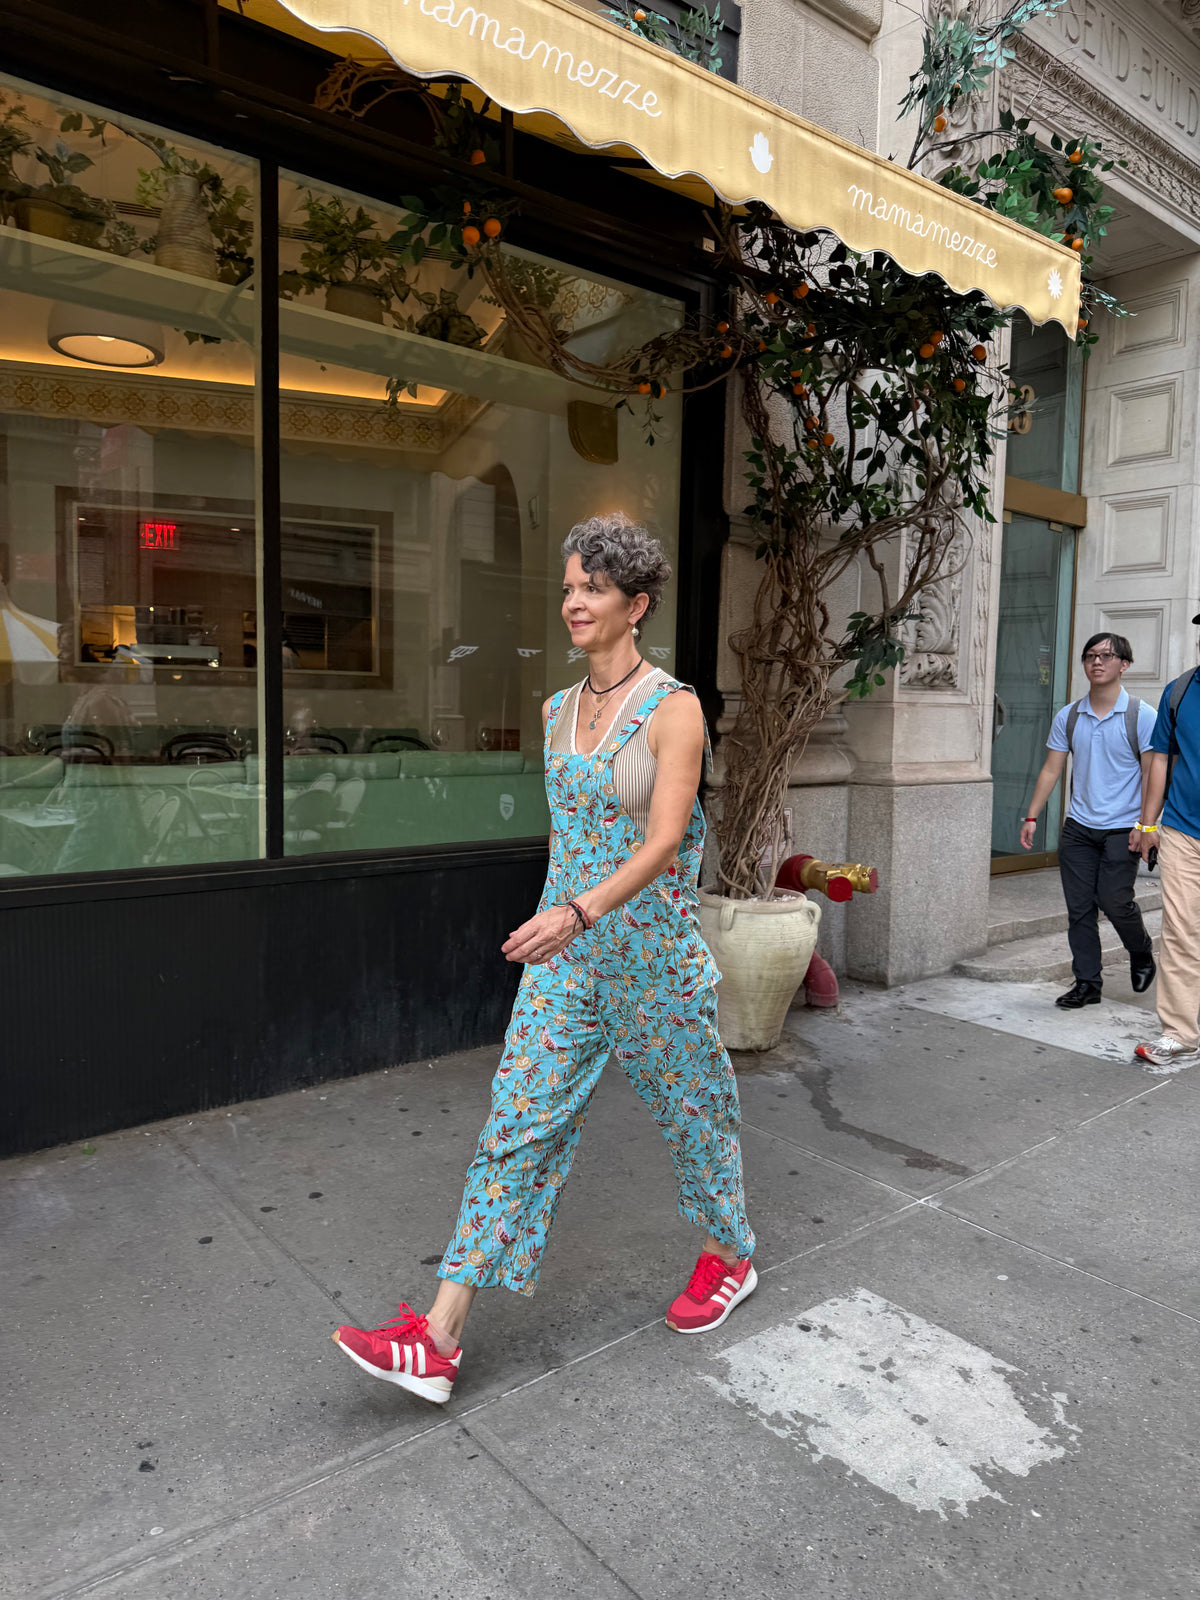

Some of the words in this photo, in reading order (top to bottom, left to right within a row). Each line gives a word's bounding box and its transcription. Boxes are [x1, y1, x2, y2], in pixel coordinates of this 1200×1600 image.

[1139, 47, 1199, 137] BUILD
[848, 184, 997, 268] mamamezze
[144, 523, 176, 547] EXIT
